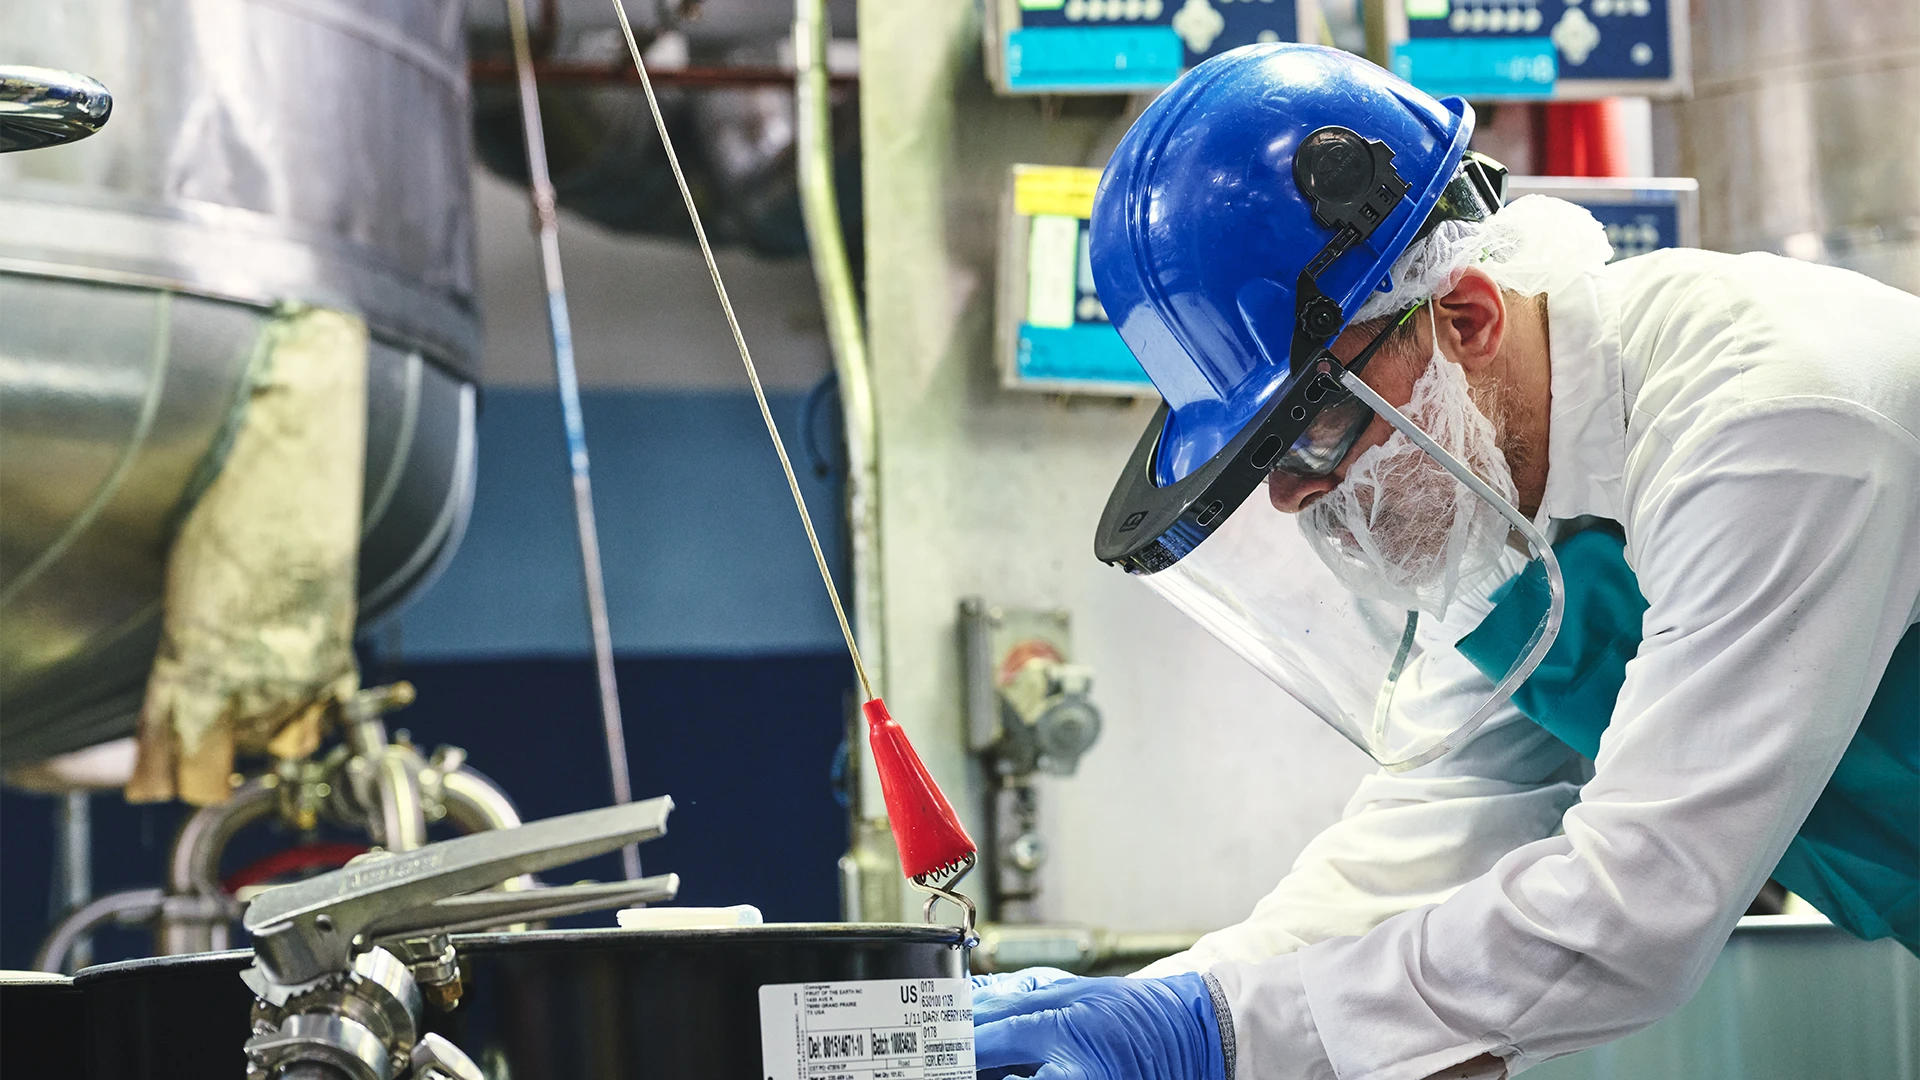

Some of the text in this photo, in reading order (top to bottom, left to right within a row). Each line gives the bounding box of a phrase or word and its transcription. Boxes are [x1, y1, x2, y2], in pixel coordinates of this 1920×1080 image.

[920, 980, 934, 992] 0178
[900, 984, 918, 1004] US
[923, 1026, 938, 1038] 0178
